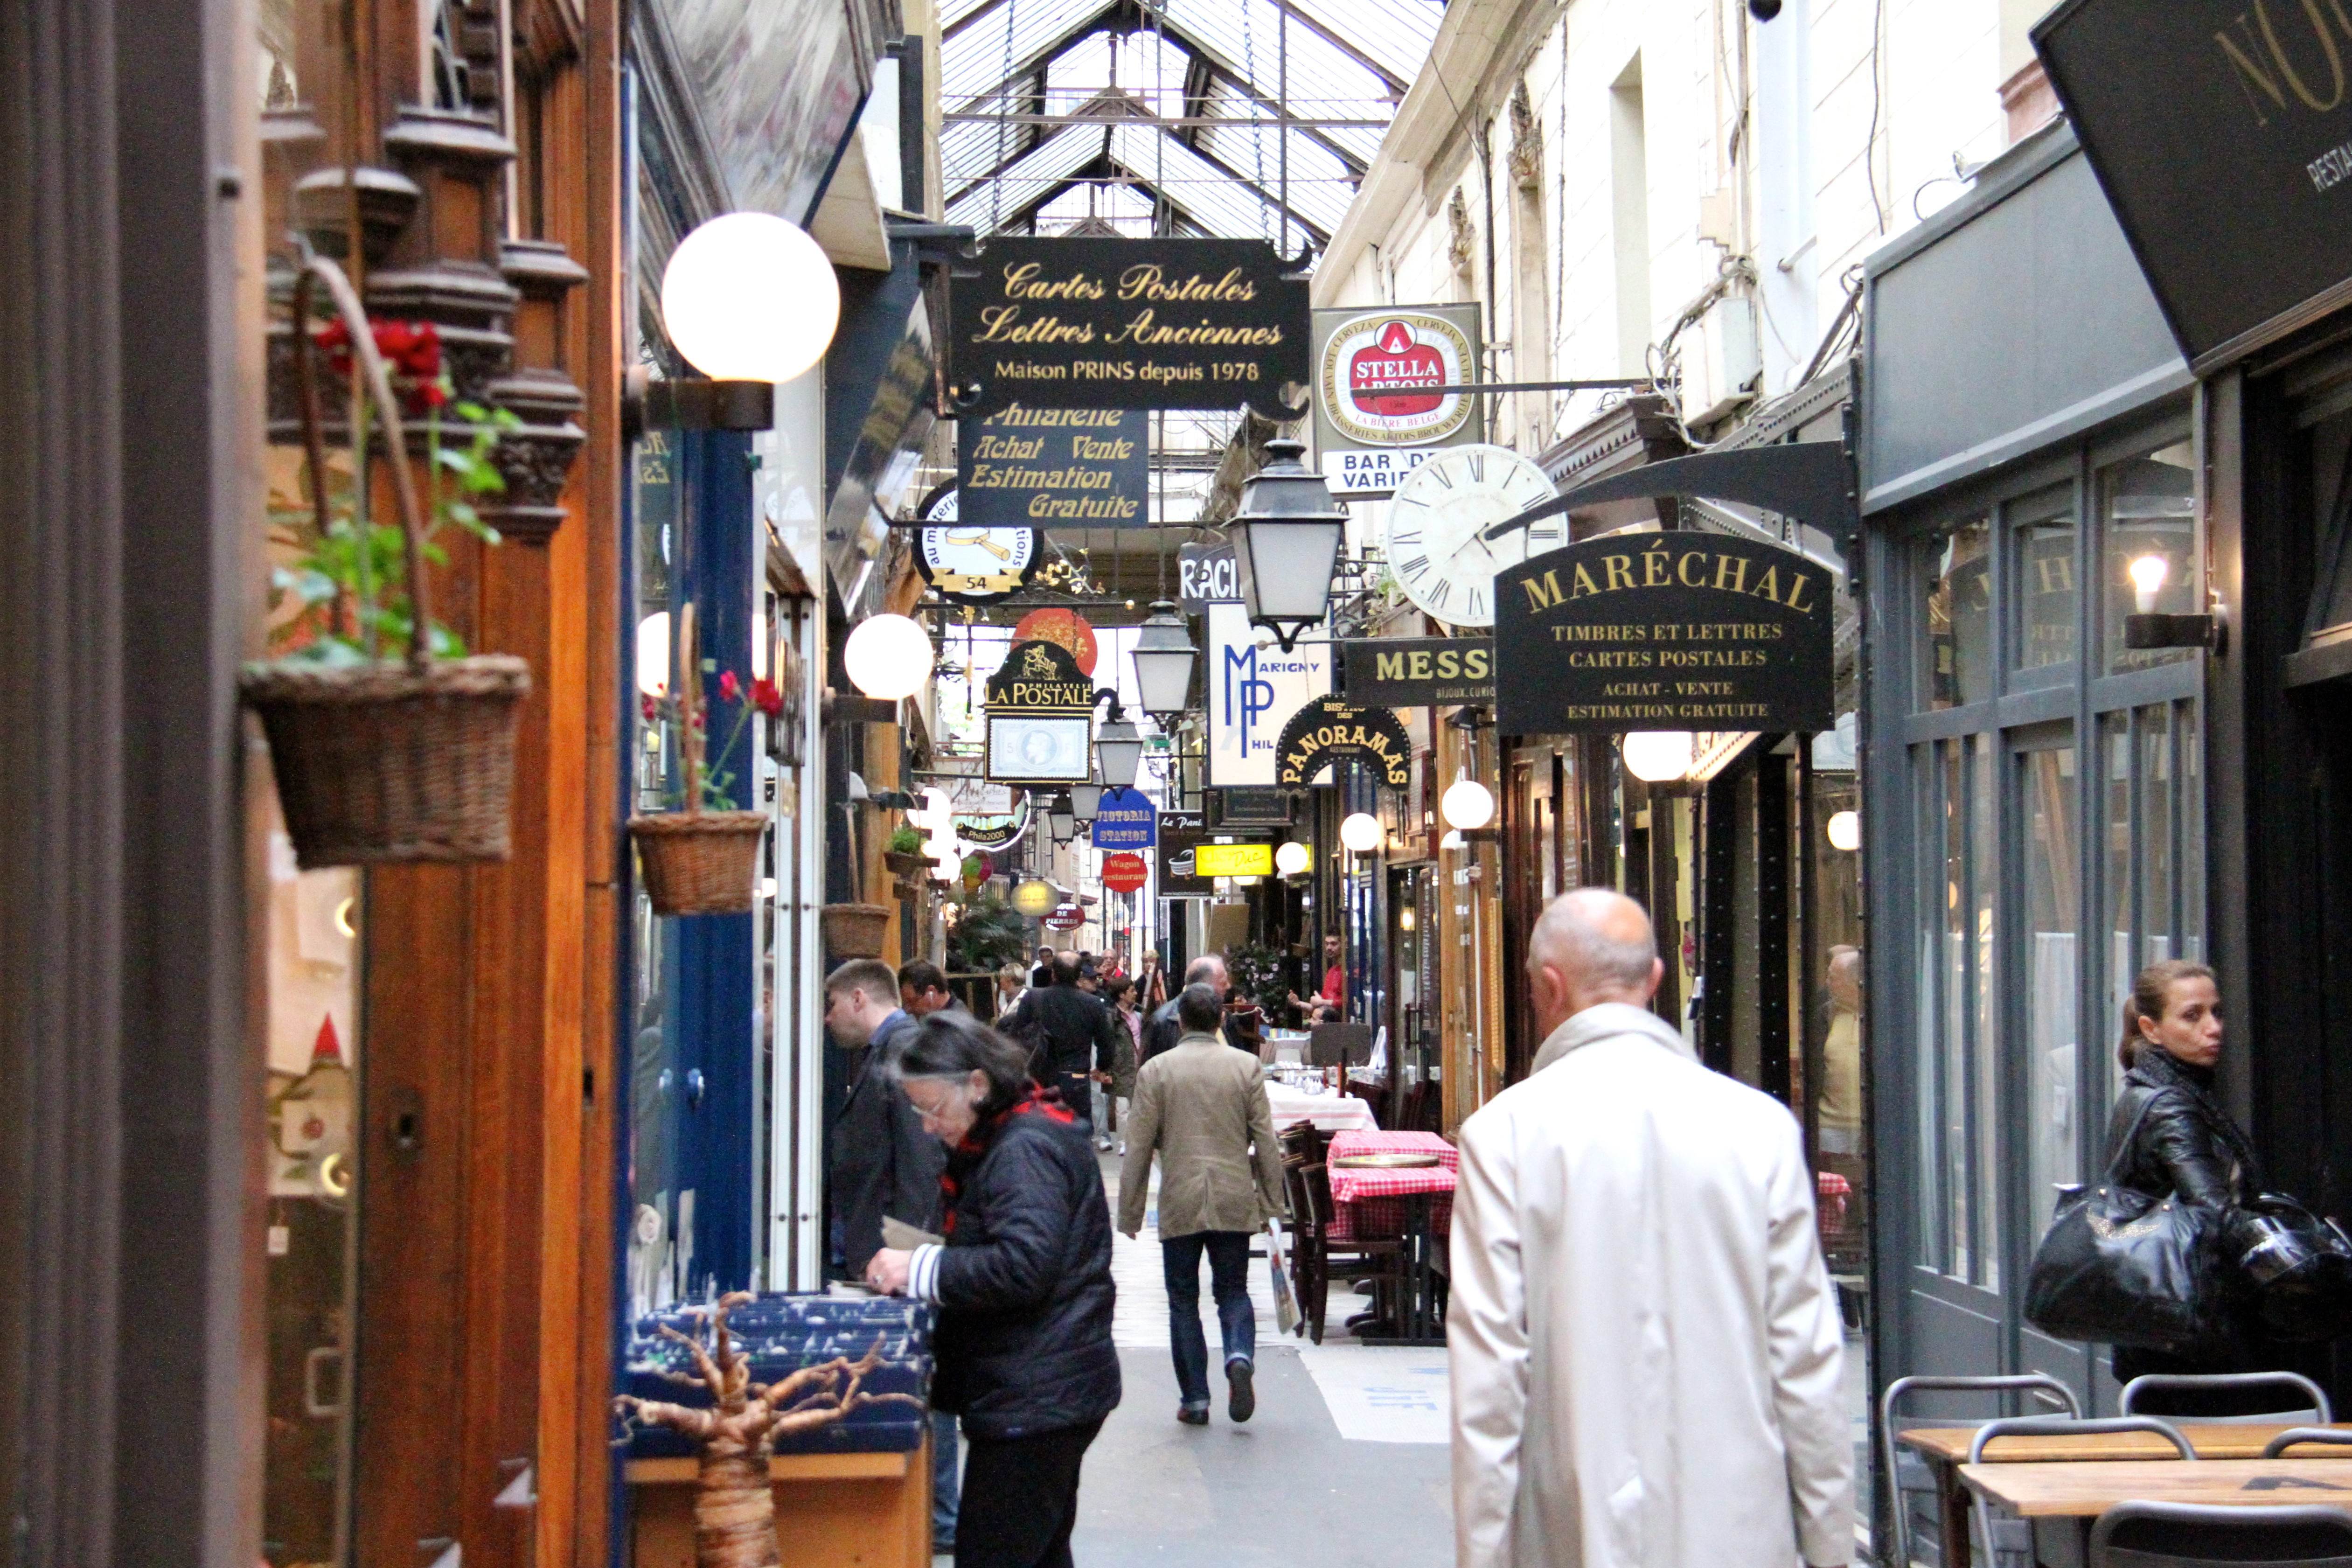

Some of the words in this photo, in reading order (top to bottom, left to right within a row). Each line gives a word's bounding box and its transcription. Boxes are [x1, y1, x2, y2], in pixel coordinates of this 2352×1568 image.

[2306, 141, 2352, 192] RESTA
[1003, 261, 1105, 300] Cartes
[1117, 264, 1256, 301] Postales
[971, 304, 1095, 344] Lettres
[1104, 308, 1283, 345] Anciennes
[995, 362, 1066, 379] Maison
[1073, 362, 1134, 379] PRINS
[1140, 362, 1203, 385] depuis
[1211, 363, 1259, 380] 1978
[1356, 360, 1440, 379] STELLA
[1355, 414, 1367, 425] LA
[1407, 411, 1442, 426] BELGE
[973, 435, 1045, 459] Achat
[1073, 435, 1134, 459] Vente
[1344, 454, 1391, 470] BAR
[967, 465, 1112, 488] Estimation
[1029, 494, 1138, 518] Gratuite
[966, 577, 987, 590] 54
[1180, 558, 1244, 599] RACI
[1519, 538, 1814, 614] MARÉCHAL
[1552, 625, 1646, 641] TIMBRES
[1654, 625, 1679, 641] ET
[1686, 624, 1783, 641] LETTRES
[1376, 649, 1495, 681] MESS
[1569, 652, 1651, 668] CARTES
[1659, 650, 1768, 667] POSTALES
[985, 683, 1009, 704] LA
[1013, 683, 1092, 705] POSTALE
[1602, 682, 1661, 697] ACHAT
[1675, 682, 1734, 697] VENTE
[1567, 705, 1675, 719] ESTIMATION
[1679, 703, 1769, 718] GRATUITE
[1282, 725, 1407, 784] PANORAMAS
[1097, 810, 1152, 822] VICTORIA
[1161, 816, 1174, 827] Le
[1176, 816, 1203, 829] Pani
[968, 830, 1005, 842] Phila2000
[1099, 830, 1148, 842] STATION
[1110, 860, 1140, 870] Wagon
